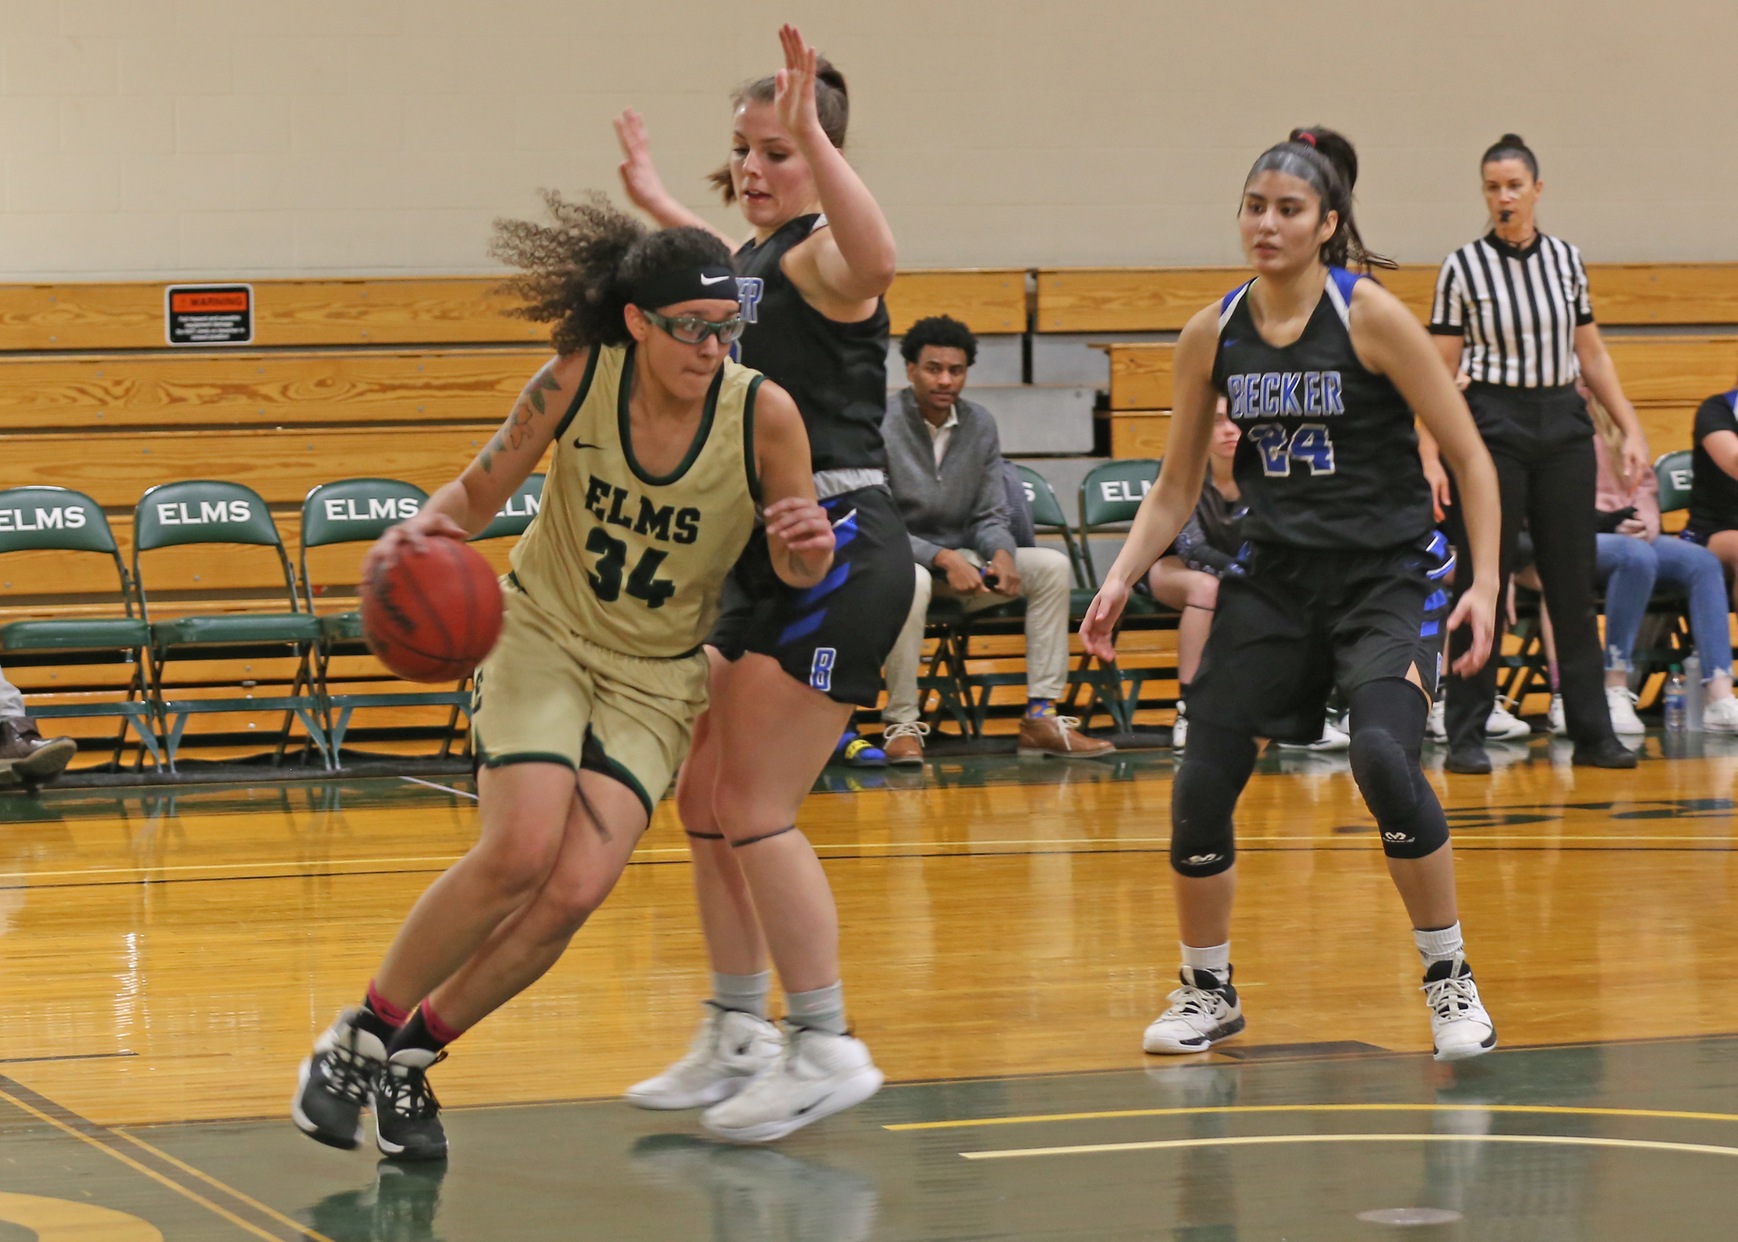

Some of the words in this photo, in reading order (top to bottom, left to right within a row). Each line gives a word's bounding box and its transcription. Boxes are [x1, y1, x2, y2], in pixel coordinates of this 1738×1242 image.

[1227, 371, 1345, 419] BECKER
[1247, 423, 1336, 477] 24
[496, 494, 541, 516] LM
[1100, 480, 1153, 501] EL
[0, 506, 86, 531] ELMS
[157, 500, 251, 525] ELMS
[326, 497, 419, 520] ELMS
[585, 474, 701, 545] ELMS
[585, 526, 675, 609] 34
[810, 647, 837, 692] B
